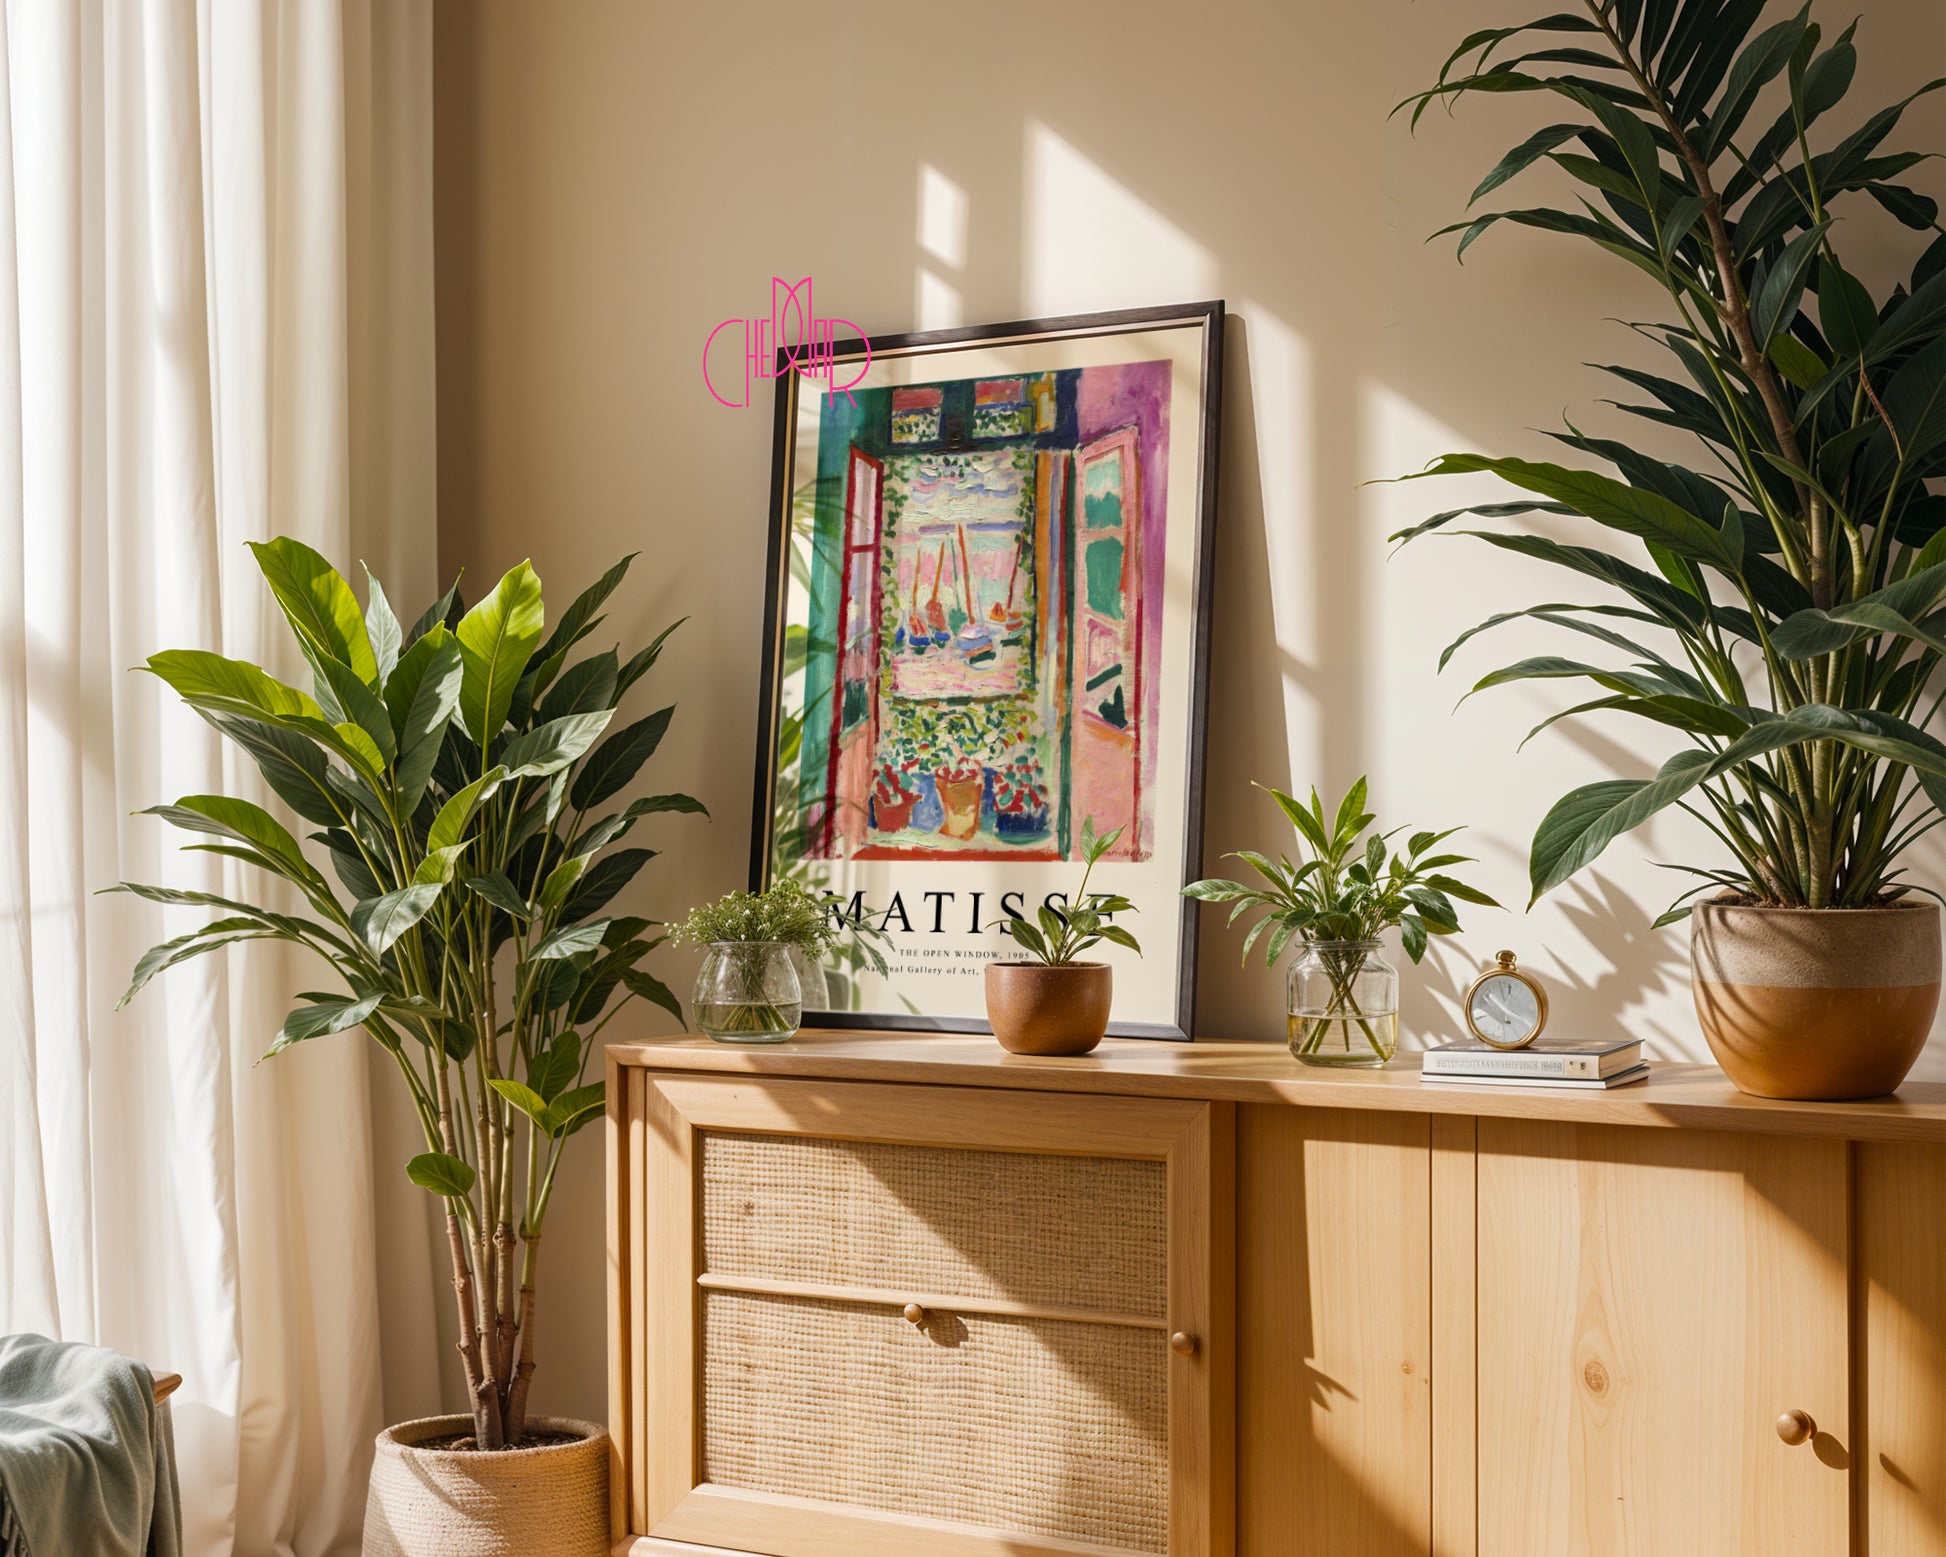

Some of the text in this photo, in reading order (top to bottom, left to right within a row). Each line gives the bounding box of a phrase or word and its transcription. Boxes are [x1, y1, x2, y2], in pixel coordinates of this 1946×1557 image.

[899, 949, 919, 957] THE
[923, 950, 950, 958] OPEN
[1007, 952, 1030, 960] 1905
[863, 964, 903, 973] Nanal
[907, 965, 942, 975] Gallery
